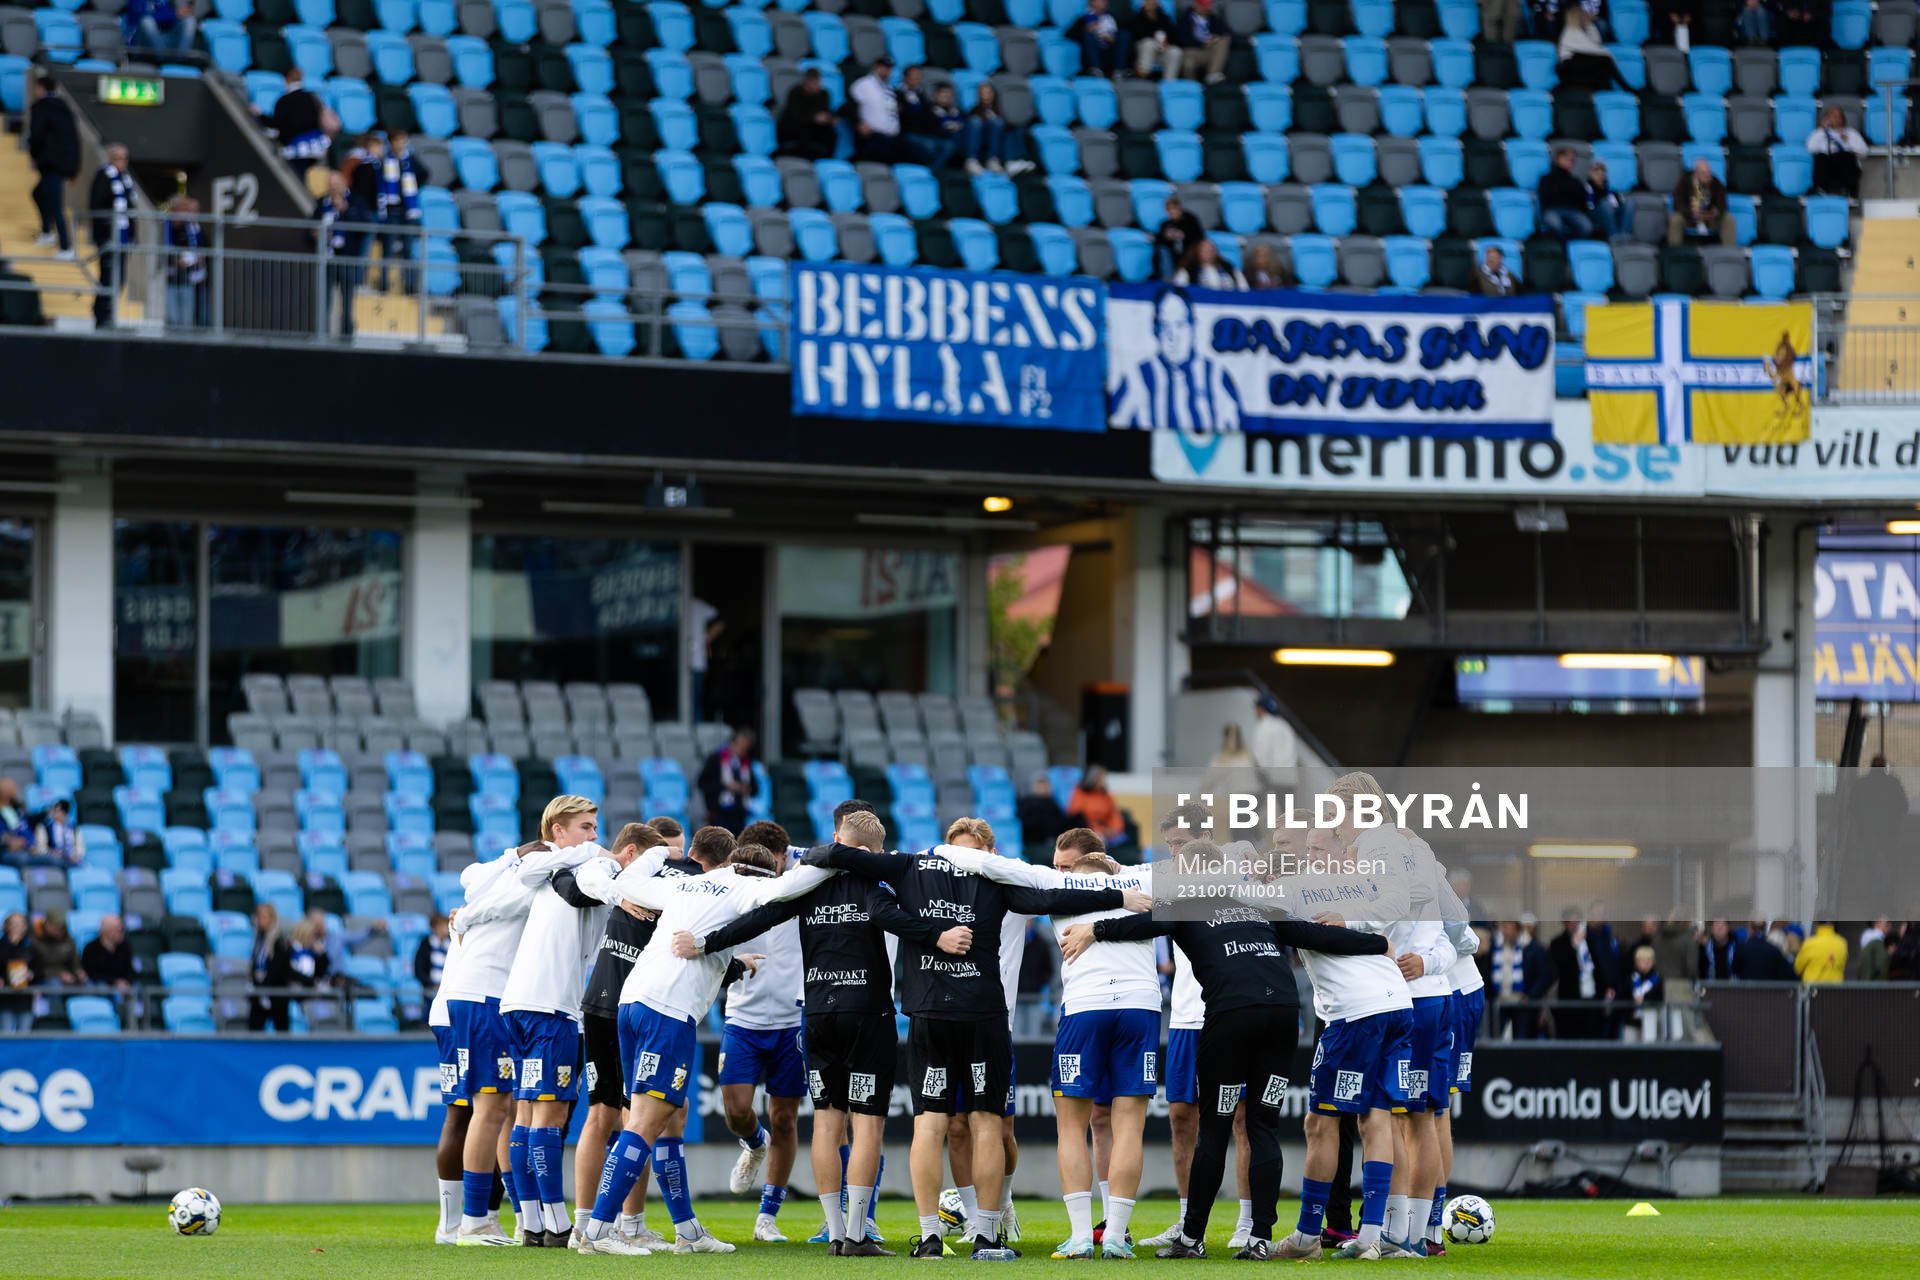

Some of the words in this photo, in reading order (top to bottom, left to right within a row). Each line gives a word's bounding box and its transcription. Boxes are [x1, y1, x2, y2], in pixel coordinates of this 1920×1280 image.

[211, 173, 259, 226] F2
[799, 270, 1097, 351] BEBBENS
[1815, 430, 1880, 467] vill
[815, 903, 858, 915] NORDIC
[806, 912, 870, 926] WELLNESS
[1060, 1056, 1076, 1065] EFF
[1061, 1064, 1079, 1073] EKT
[851, 1075, 870, 1084] EFF
[1062, 1073, 1071, 1081] IV
[1338, 1072, 1359, 1082] EFF
[851, 1082, 873, 1092] EKT
[1337, 1081, 1361, 1090] EKT
[259, 1064, 440, 1121] CRAF
[850, 1090, 862, 1099] IV
[1336, 1089, 1349, 1097] IV
[1483, 1077, 1600, 1119] Gamla
[1609, 1078, 1711, 1119] Ullevi
